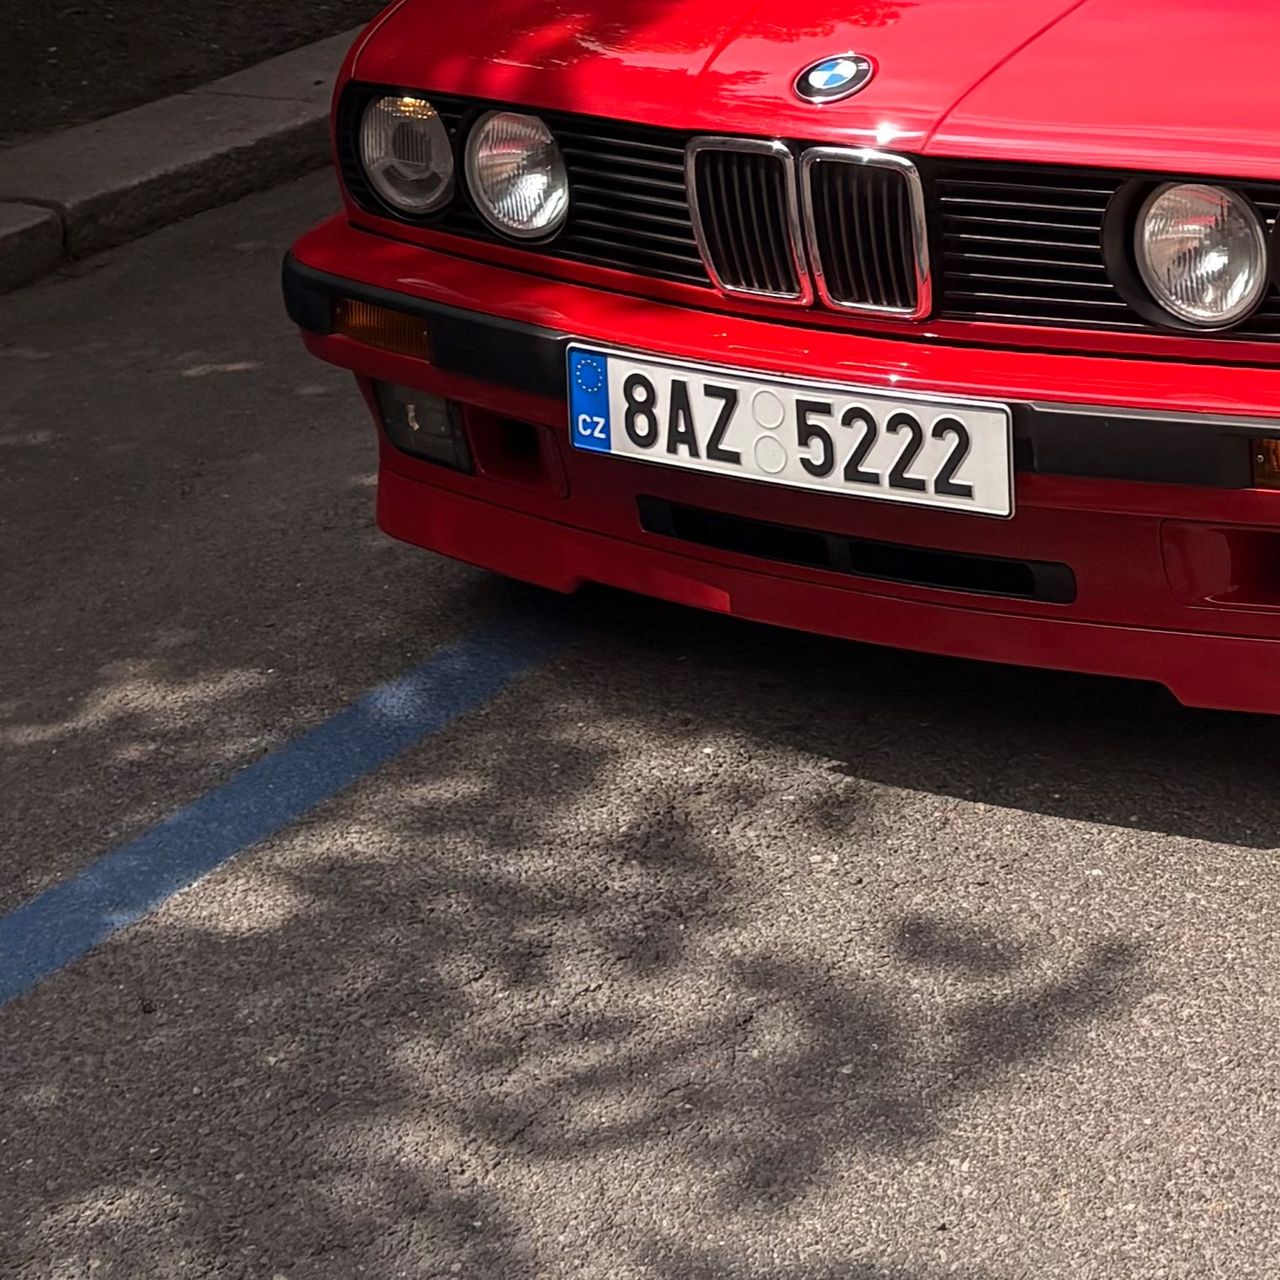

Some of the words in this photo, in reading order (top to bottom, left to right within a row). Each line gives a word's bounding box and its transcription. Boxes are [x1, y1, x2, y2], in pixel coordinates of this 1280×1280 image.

[578, 413, 606, 439] CZ
[623, 373, 742, 465] 8AZ
[795, 399, 973, 498] 5222
